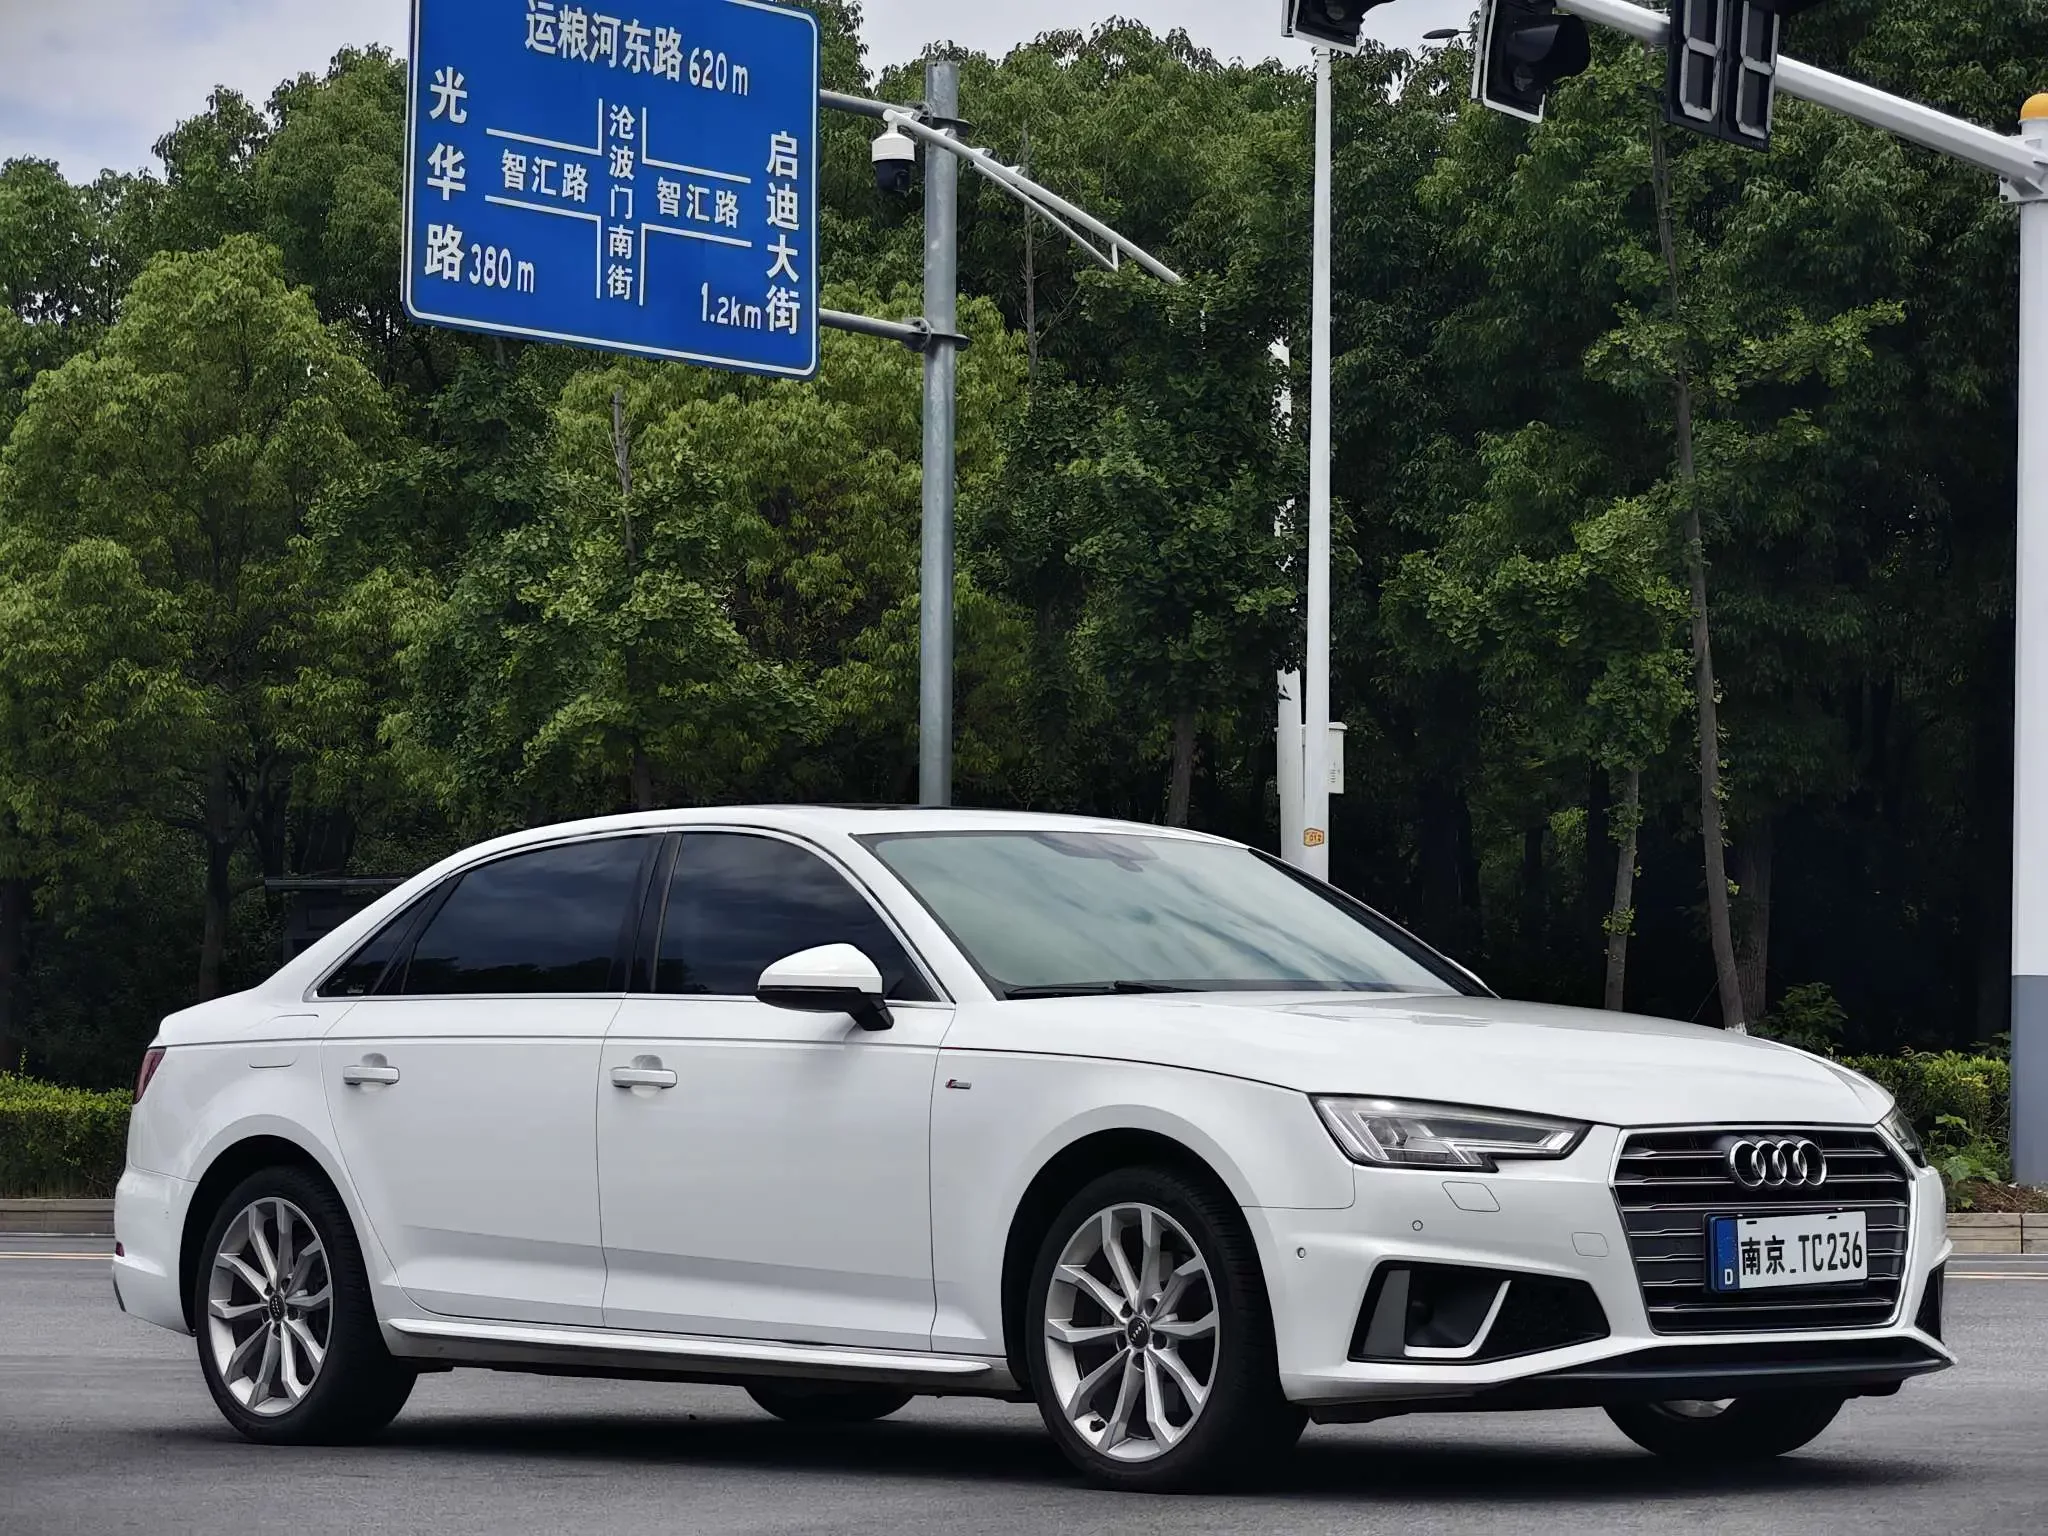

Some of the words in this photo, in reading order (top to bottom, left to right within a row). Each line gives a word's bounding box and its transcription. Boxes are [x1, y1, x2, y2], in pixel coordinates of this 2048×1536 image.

[525, 0, 683, 81] 运粮河东路
[425, 67, 468, 281] 光华路
[501, 148, 588, 203] 智汇路
[607, 105, 635, 300] 沧波门南街
[656, 177, 739, 228] 智汇路
[766, 131, 800, 334] 启迪大街
[1725, 1269, 1734, 1284] D
